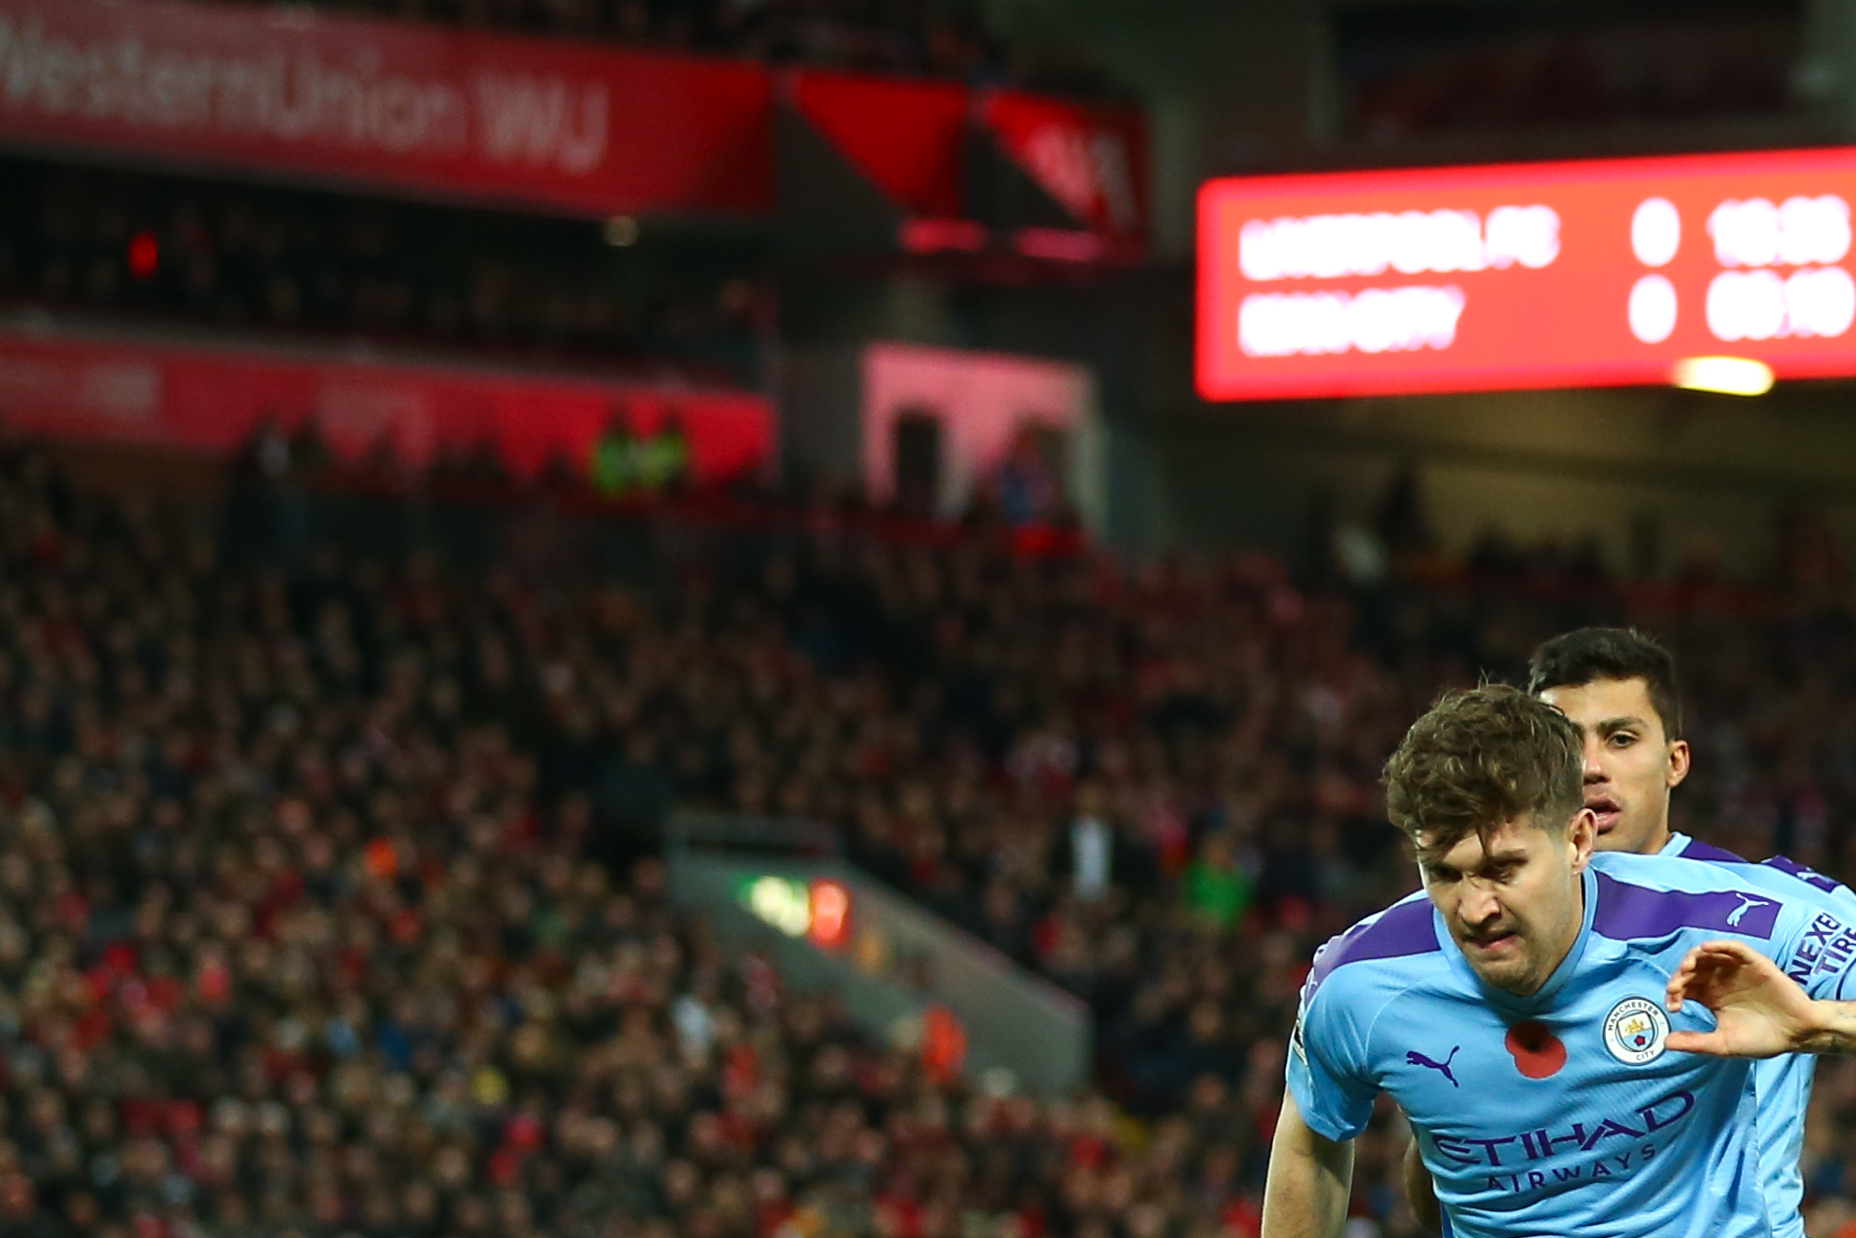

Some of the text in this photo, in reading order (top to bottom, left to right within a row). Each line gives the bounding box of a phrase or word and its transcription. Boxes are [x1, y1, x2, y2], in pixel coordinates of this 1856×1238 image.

[1631, 197, 1680, 266] 0
[1628, 274, 1677, 342] 0
[1607, 1001, 1659, 1031] MANCHESTER
[1636, 1050, 1656, 1061] CITY
[1432, 1090, 1695, 1166] ETIHAD
[1487, 1142, 1657, 1192] AIRWAYS
